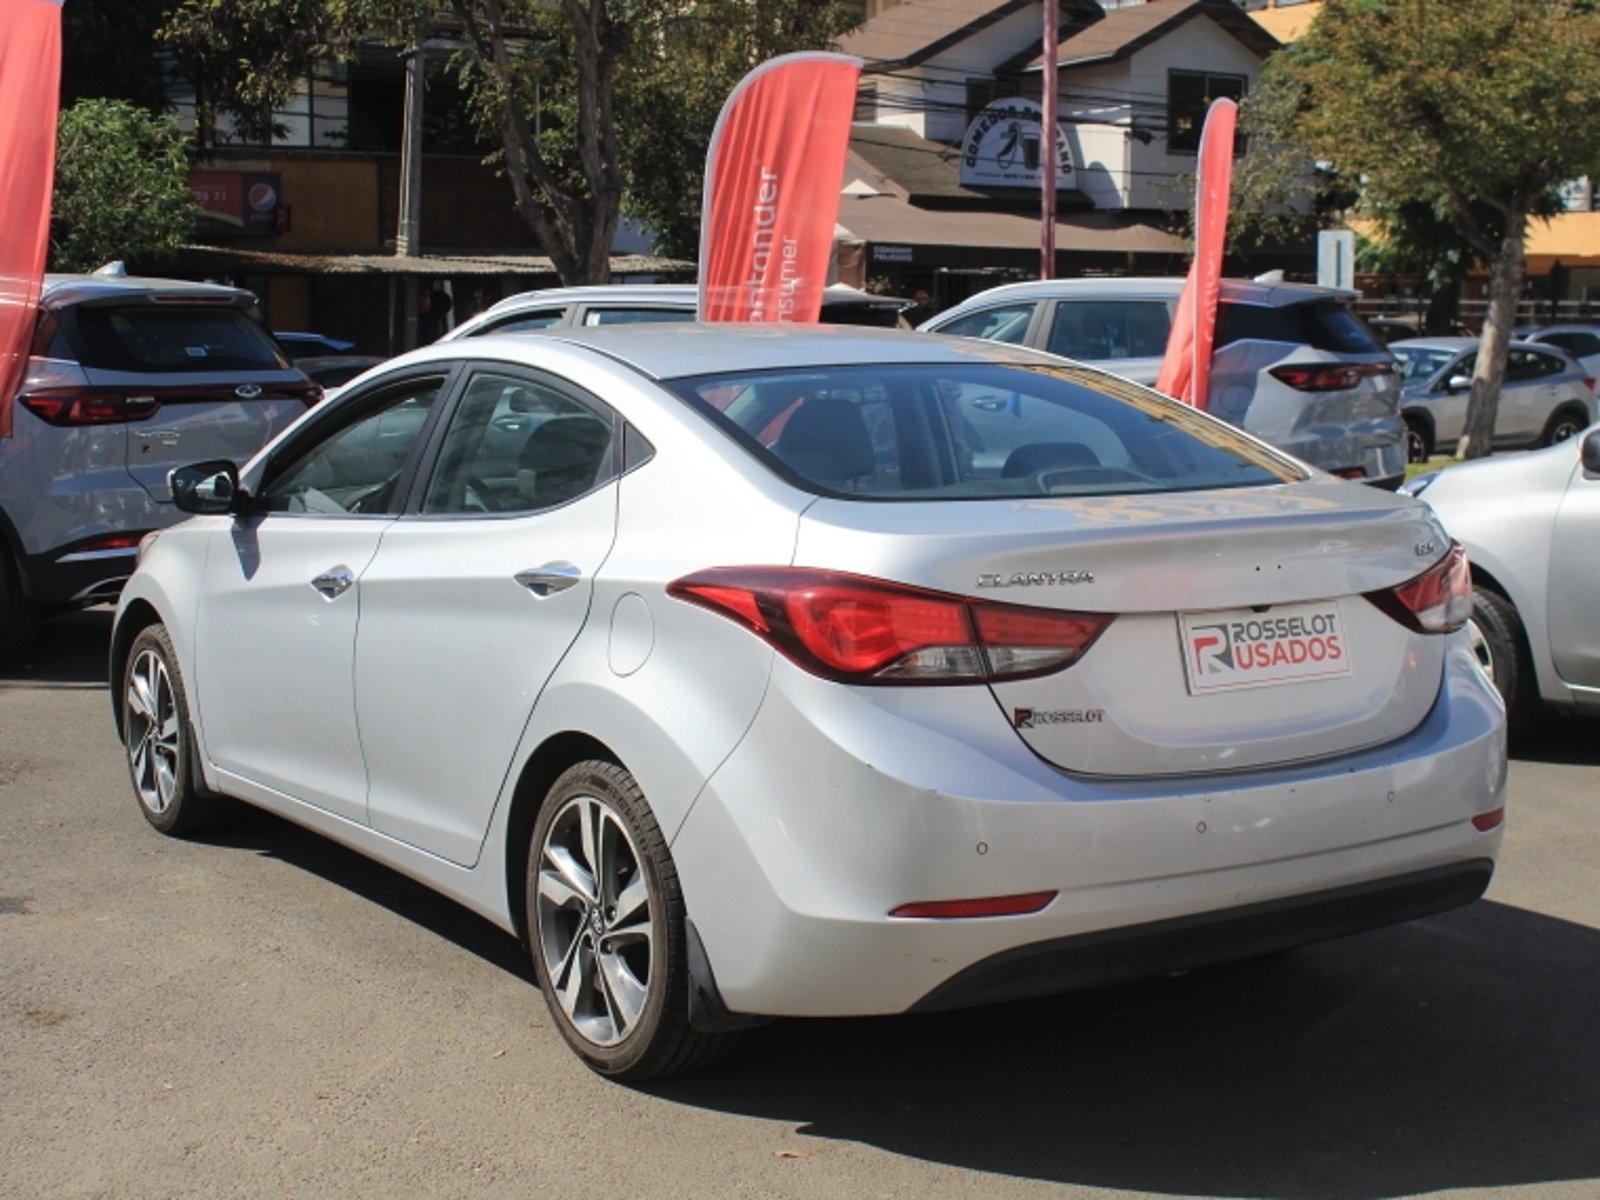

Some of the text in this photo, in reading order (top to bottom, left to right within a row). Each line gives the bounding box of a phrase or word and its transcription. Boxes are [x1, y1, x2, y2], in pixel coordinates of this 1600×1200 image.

[966, 105, 1016, 168] COMEDOR
[976, 570, 1095, 588] ELANTRA
[1231, 614, 1336, 643] ROSSELOT
[1235, 635, 1342, 671] USADOS
